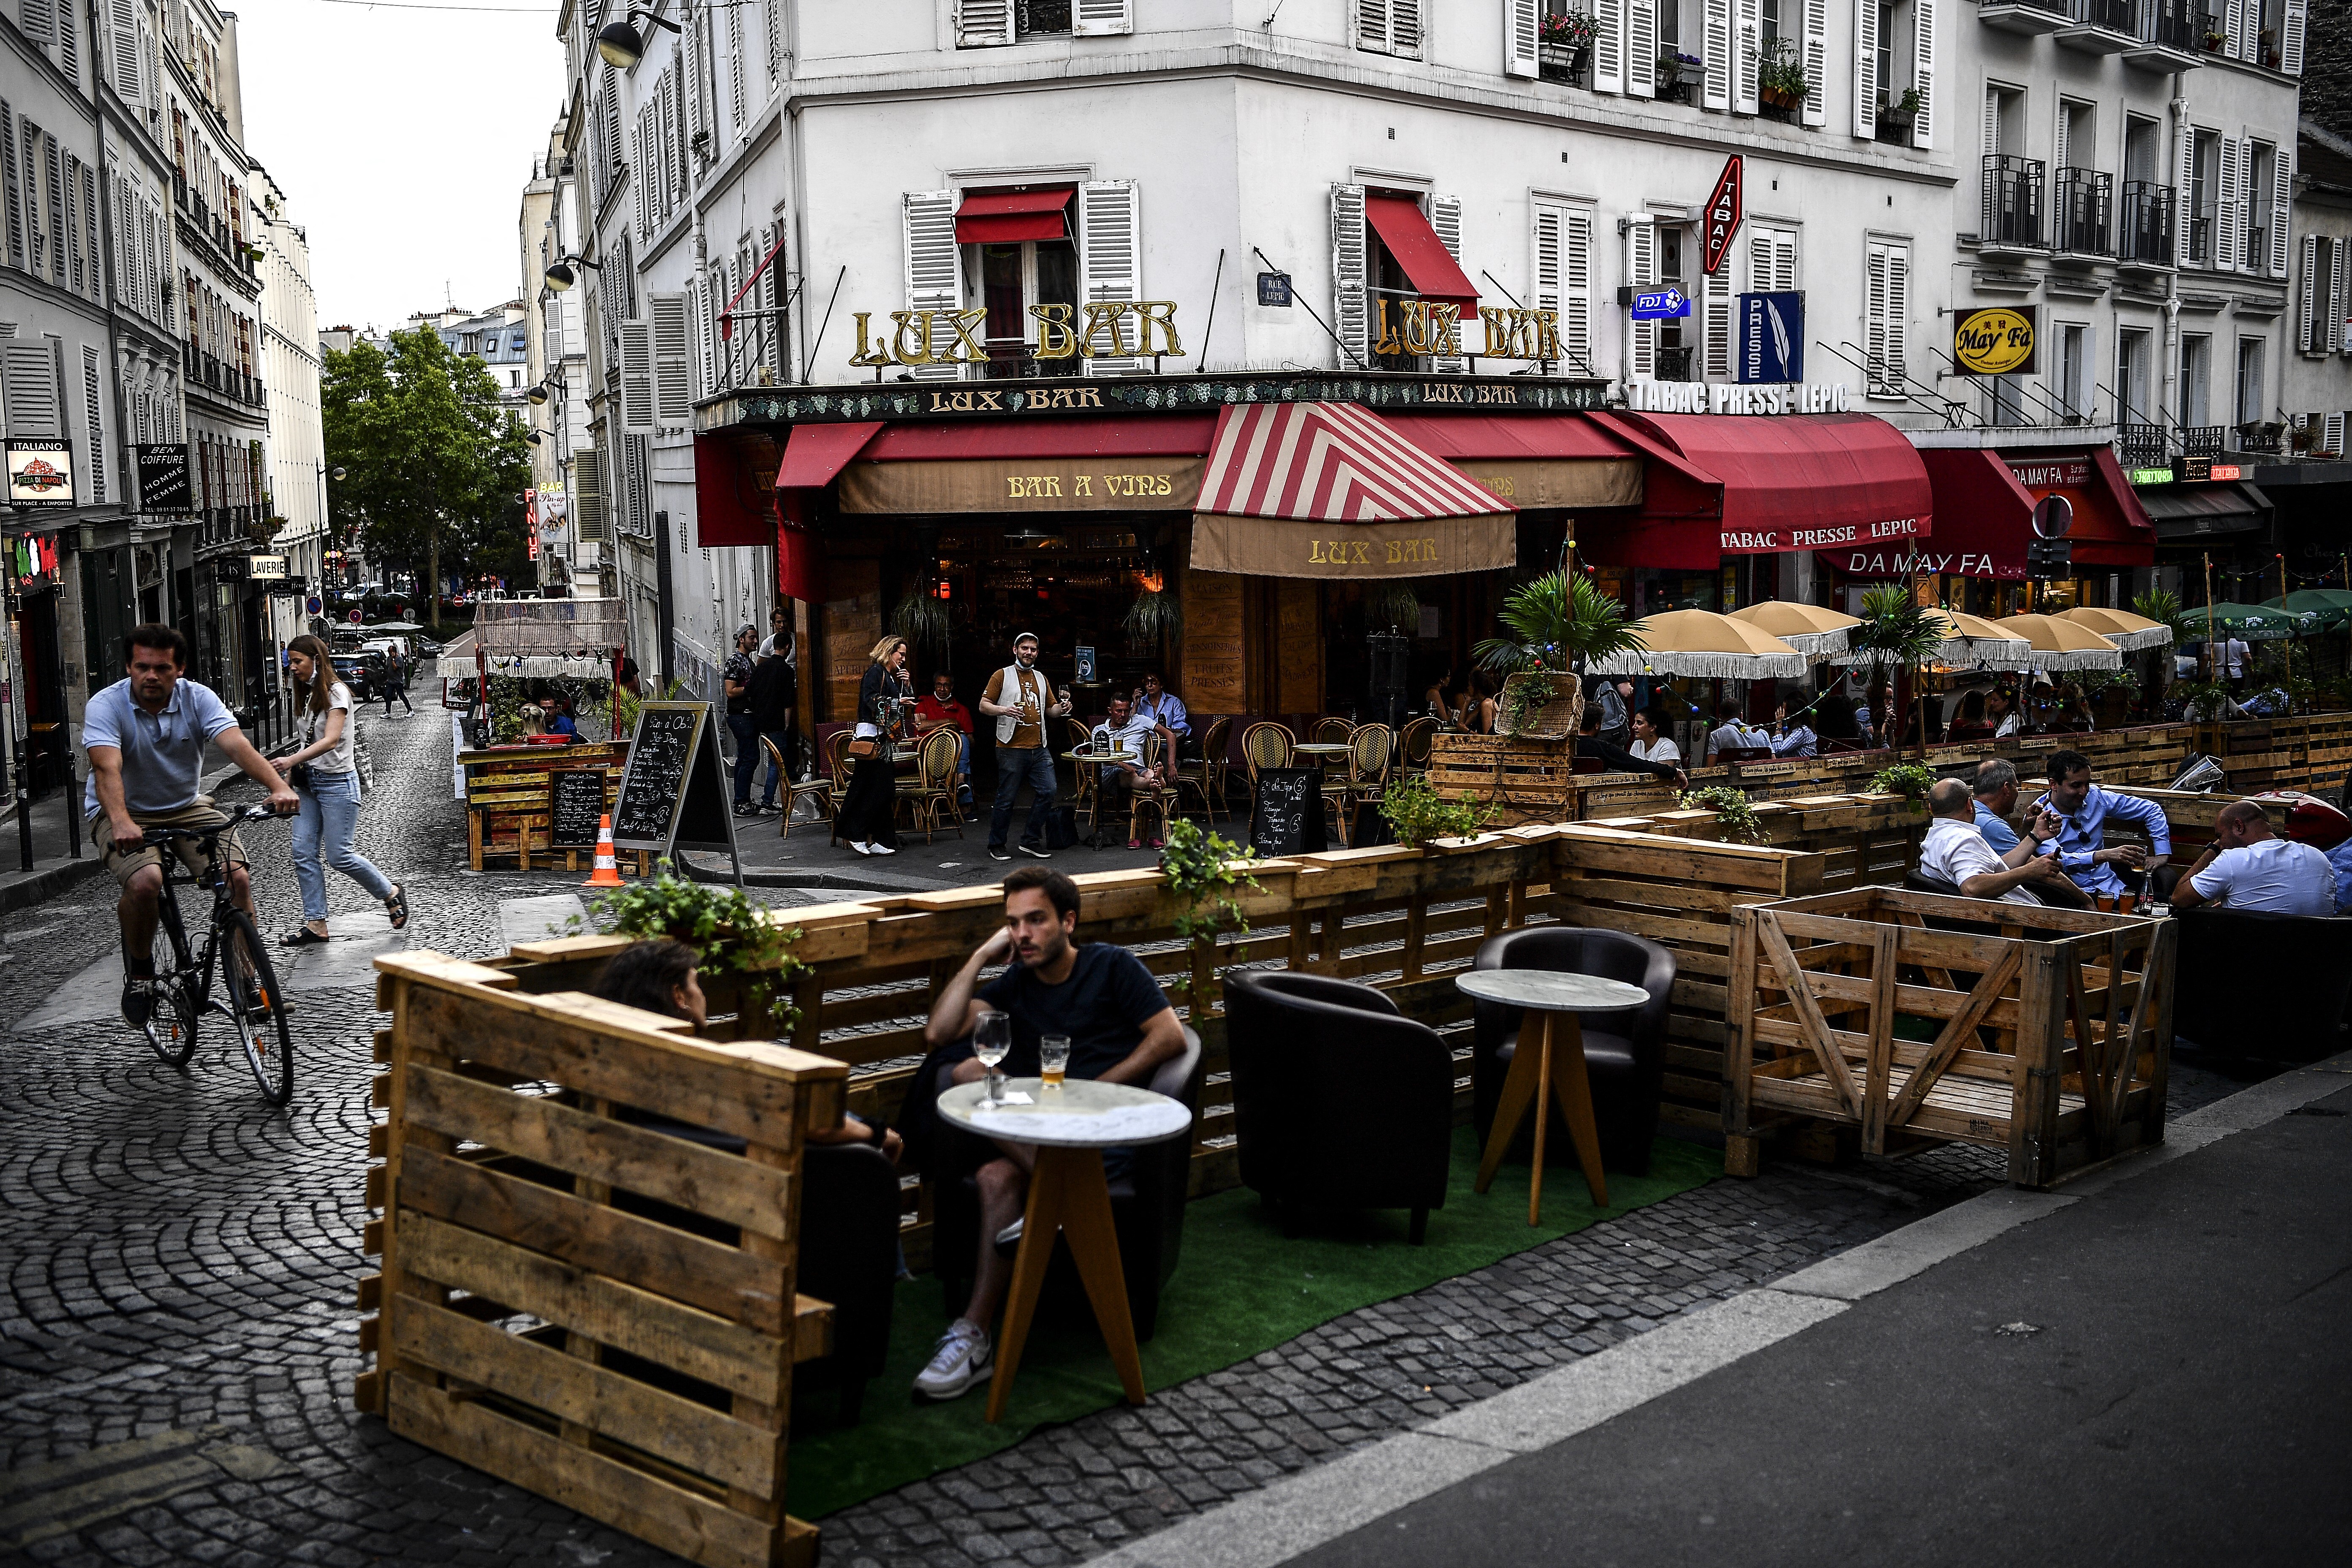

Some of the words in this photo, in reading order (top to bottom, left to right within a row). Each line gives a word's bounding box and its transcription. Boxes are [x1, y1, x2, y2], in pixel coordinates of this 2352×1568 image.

[1710, 182, 1735, 250] TABAC
[1268, 280, 1282, 289] RUE
[1266, 292, 1285, 300] LEPIC
[1639, 296, 1661, 308] FDJ
[849, 307, 991, 368] LUX
[1028, 300, 1187, 360] BAR
[1375, 299, 1463, 356] LUX
[1478, 305, 1565, 361] BAR
[1749, 299, 1761, 378] PRESSE
[1957, 328, 2003, 359] May
[2007, 327, 2031, 348] Fa
[929, 390, 1004, 413] LUX
[1025, 387, 1104, 409] BAR
[1423, 383, 1465, 403] LUX
[1476, 385, 1518, 404] BAR
[1634, 381, 1706, 414] TABAC
[1711, 384, 1791, 414] PRESSE
[1796, 384, 1850, 414] LEPIC
[14, 443, 63, 451] ITALIANO
[141, 455, 185, 464] COIFFURE
[144, 466, 185, 491] HOMME
[1007, 475, 1063, 498] BAR
[1075, 475, 1094, 497] A
[1103, 474, 1172, 496] VINS
[2028, 468, 2048, 485] MAY
[2050, 467, 2062, 484] FA
[146, 481, 185, 504] FEMME
[540, 481, 564, 493] BAR
[1720, 531, 1777, 549] TABAC
[1792, 525, 1856, 547] PRESSE
[1871, 518, 1917, 538] LEPIC
[1308, 540, 1370, 565] LUX
[1386, 538, 1437, 564] BAR
[251, 561, 285, 574] LAVERIE
[1848, 553, 1886, 573] DA
[1892, 554, 1954, 573] MAY
[1959, 554, 1994, 574] FA
[1190, 583, 1233, 594] MAISON
[2245, 615, 2263, 628] perrier
[1195, 663, 1233, 674] FRUITS
